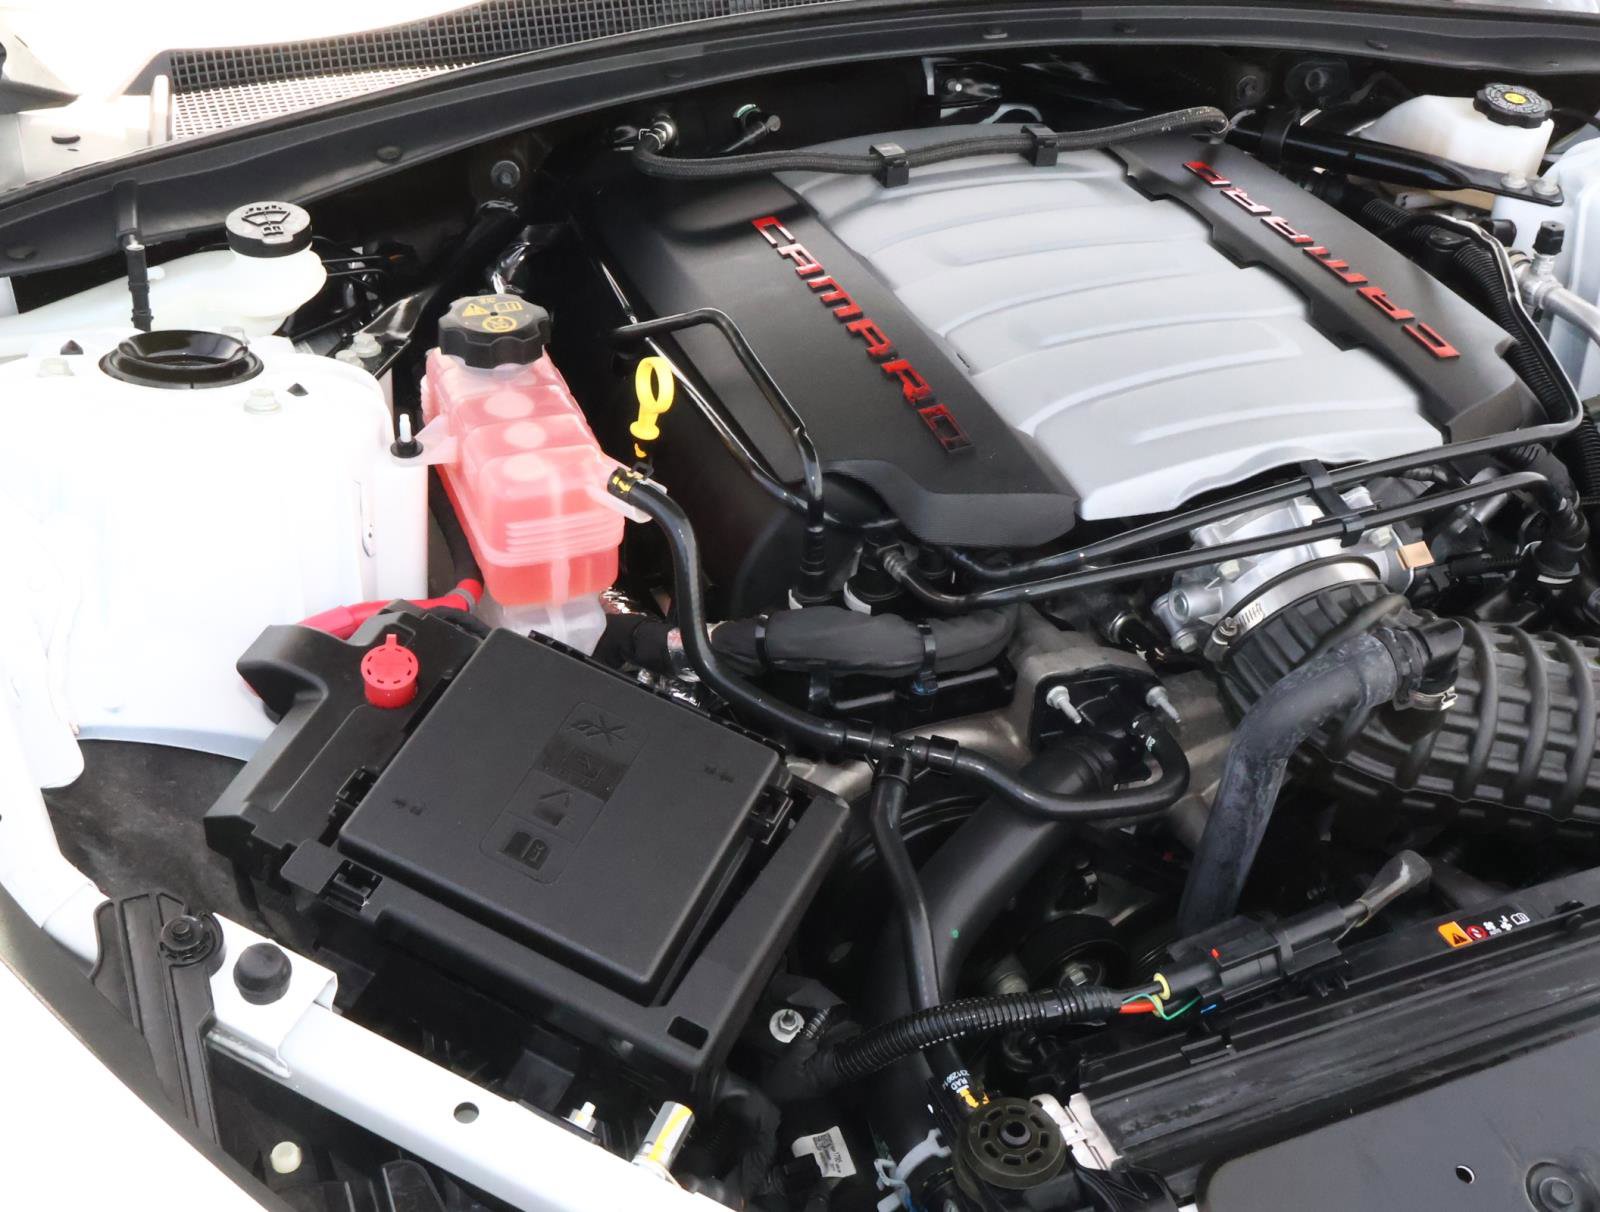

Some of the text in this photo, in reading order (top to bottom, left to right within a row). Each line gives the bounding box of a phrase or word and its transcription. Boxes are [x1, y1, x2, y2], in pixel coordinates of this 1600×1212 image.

[752, 216, 974, 452] CAMARO
[1183, 161, 1460, 359] CAMARO
[950, 1077, 968, 1091] RAD
